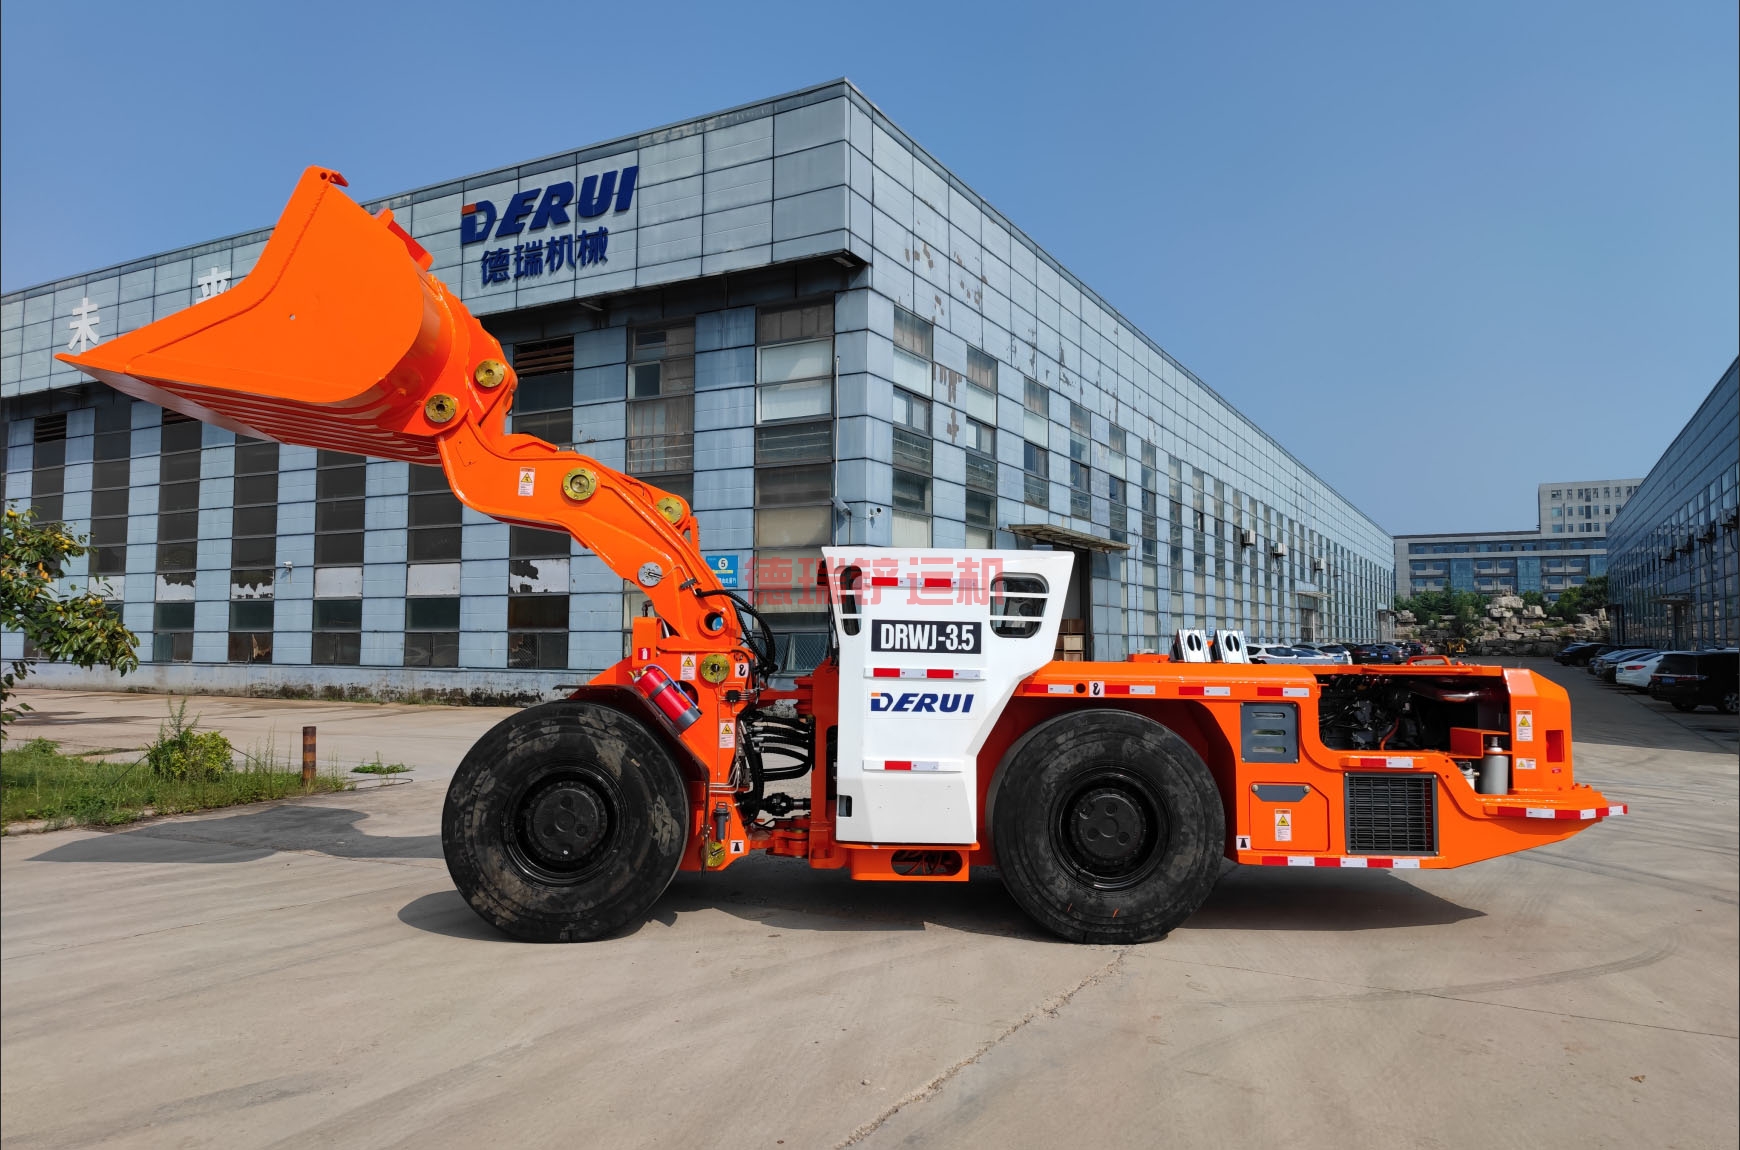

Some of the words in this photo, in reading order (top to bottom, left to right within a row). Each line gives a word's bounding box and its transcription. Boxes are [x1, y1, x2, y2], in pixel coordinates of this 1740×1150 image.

[461, 165, 639, 245] DERUI
[481, 226, 609, 285] 德瑞机械
[880, 623, 975, 651] DRWJ-3.5
[871, 692, 975, 713] DERUI
